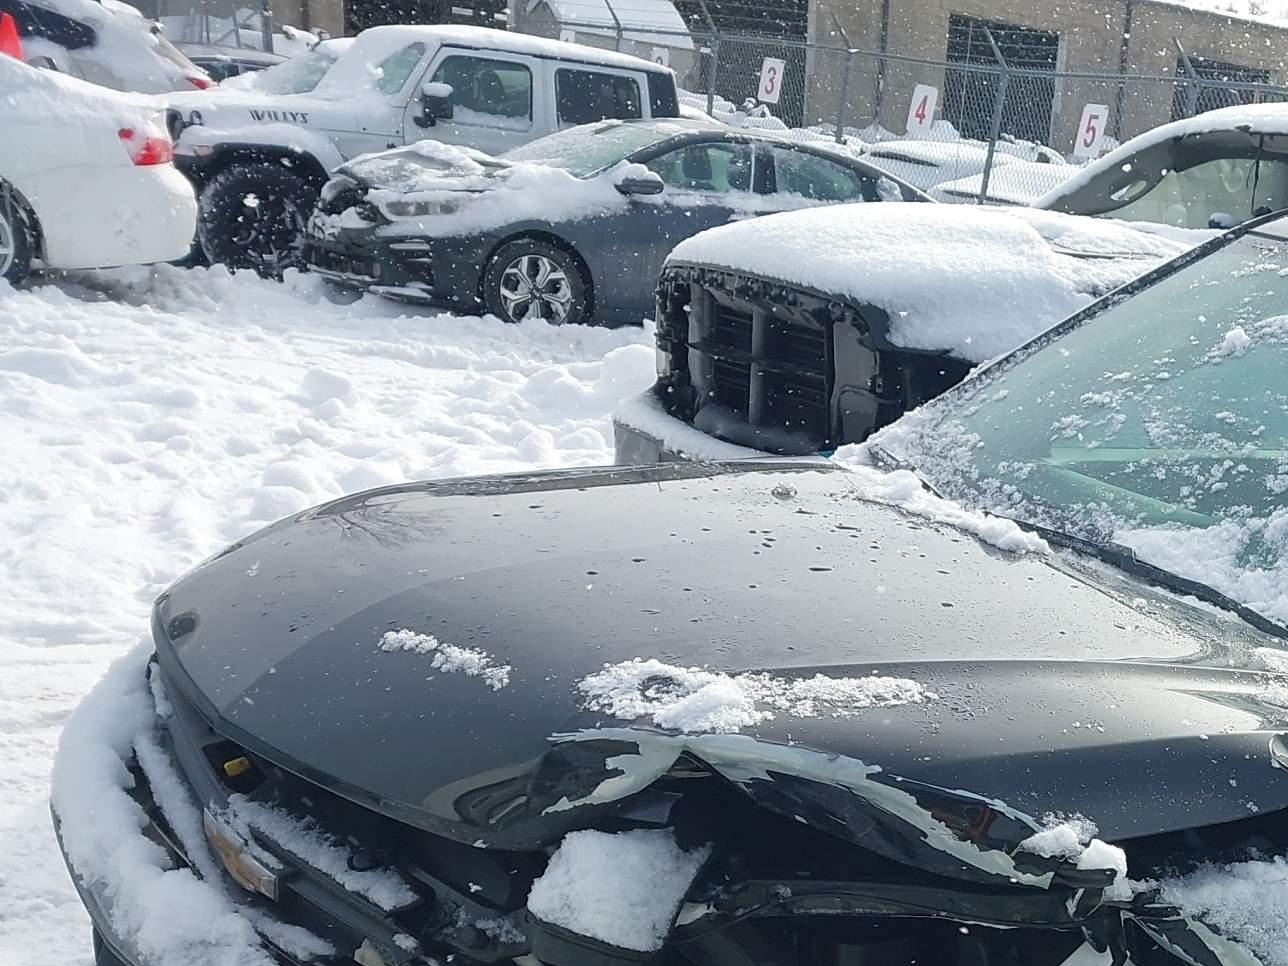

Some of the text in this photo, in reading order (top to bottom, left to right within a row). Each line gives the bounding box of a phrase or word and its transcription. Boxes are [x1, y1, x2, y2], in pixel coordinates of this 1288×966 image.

[764, 66, 777, 95] 3
[248, 109, 309, 124] WILLYS
[914, 95, 929, 125] 4
[1083, 114, 1099, 148] 5
